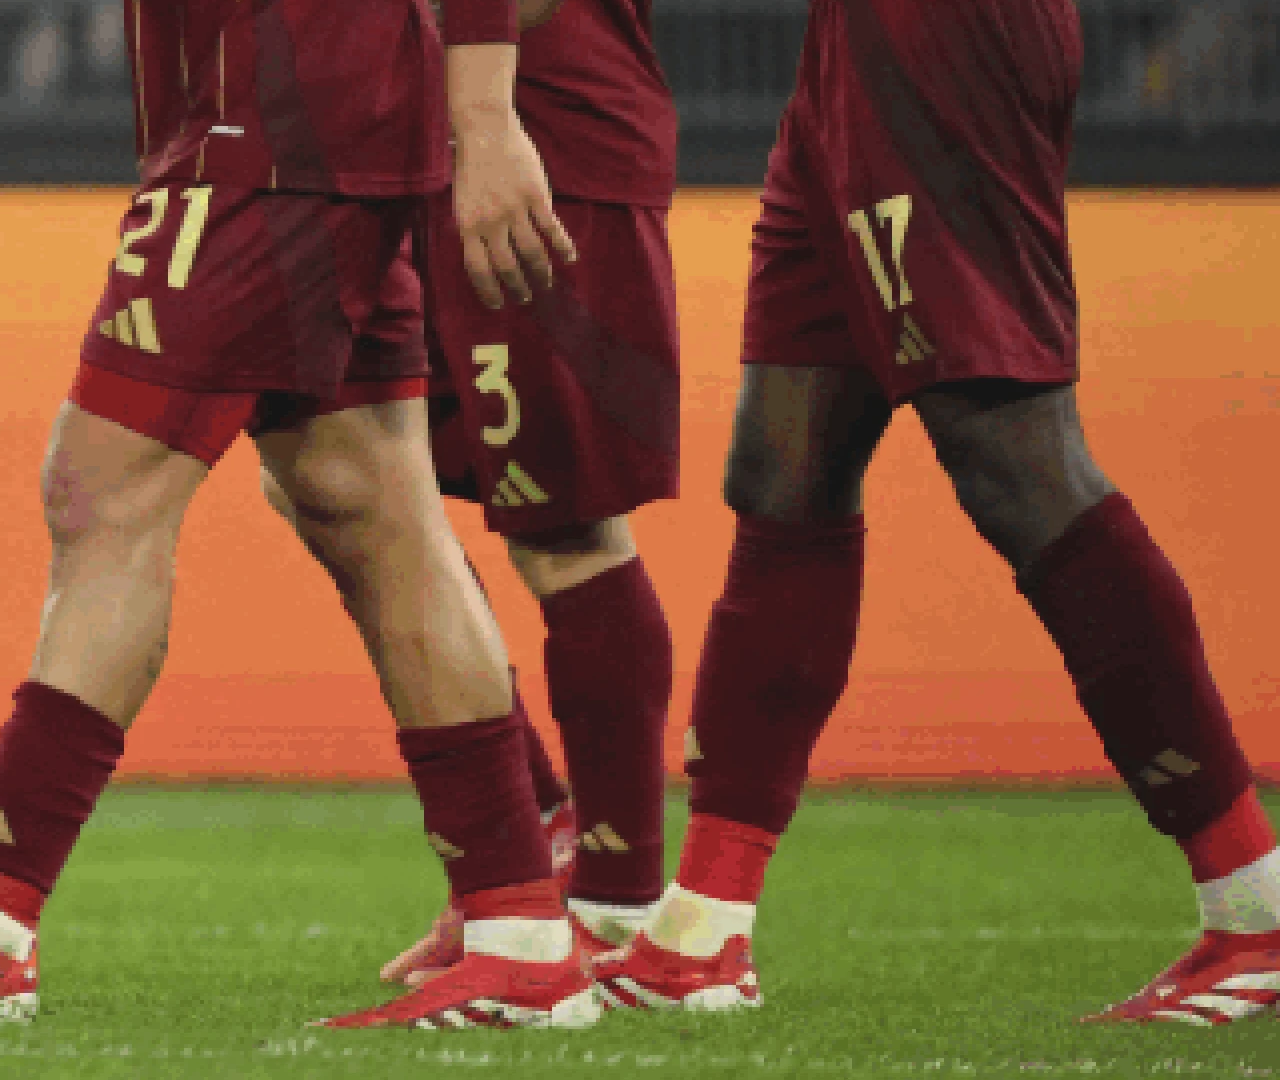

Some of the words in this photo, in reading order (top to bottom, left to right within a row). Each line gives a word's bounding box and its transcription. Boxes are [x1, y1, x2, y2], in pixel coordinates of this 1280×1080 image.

[115, 186, 213, 290] 21
[847, 193, 914, 312] 17
[471, 342, 521, 448] 3
